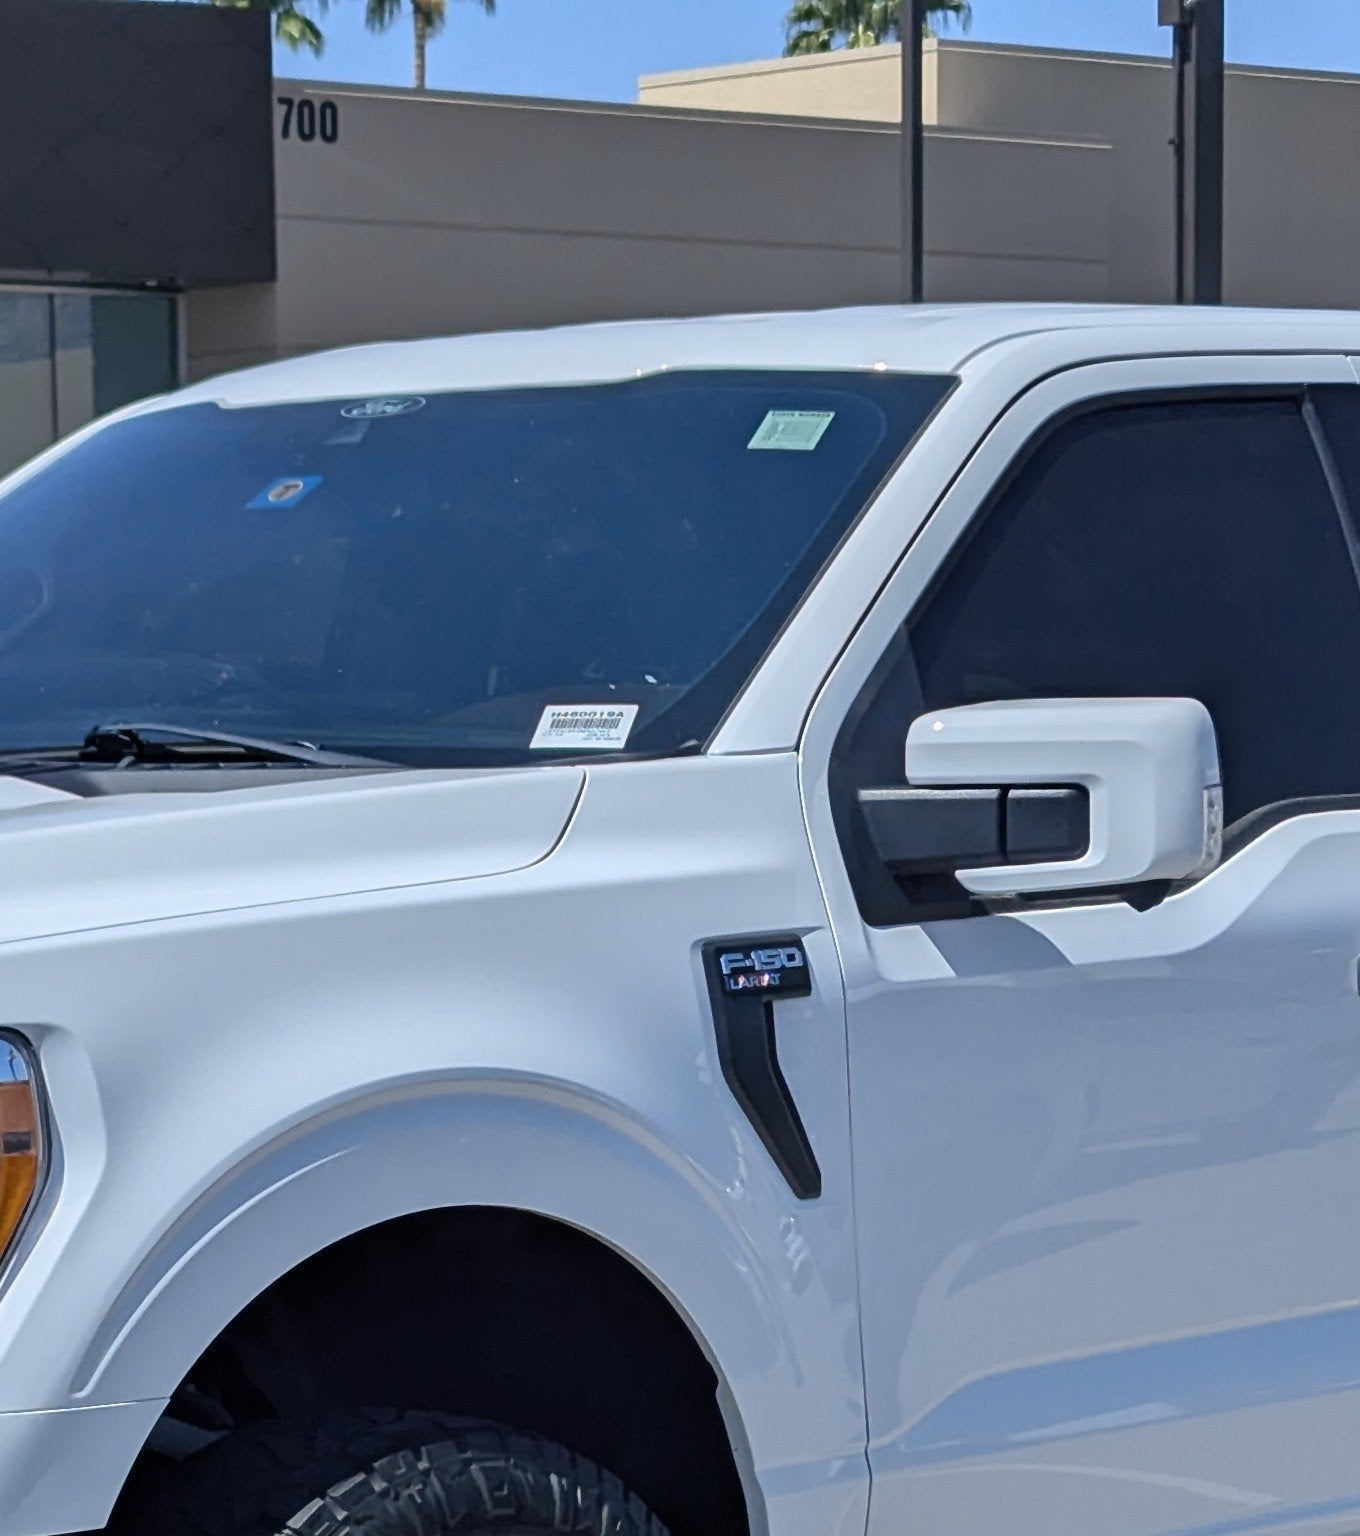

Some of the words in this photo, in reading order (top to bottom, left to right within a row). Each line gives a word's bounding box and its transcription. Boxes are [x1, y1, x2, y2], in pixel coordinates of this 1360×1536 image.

[276, 96, 339, 143] 700
[720, 946, 804, 975] F-150
[729, 972, 781, 990] LARIAT
